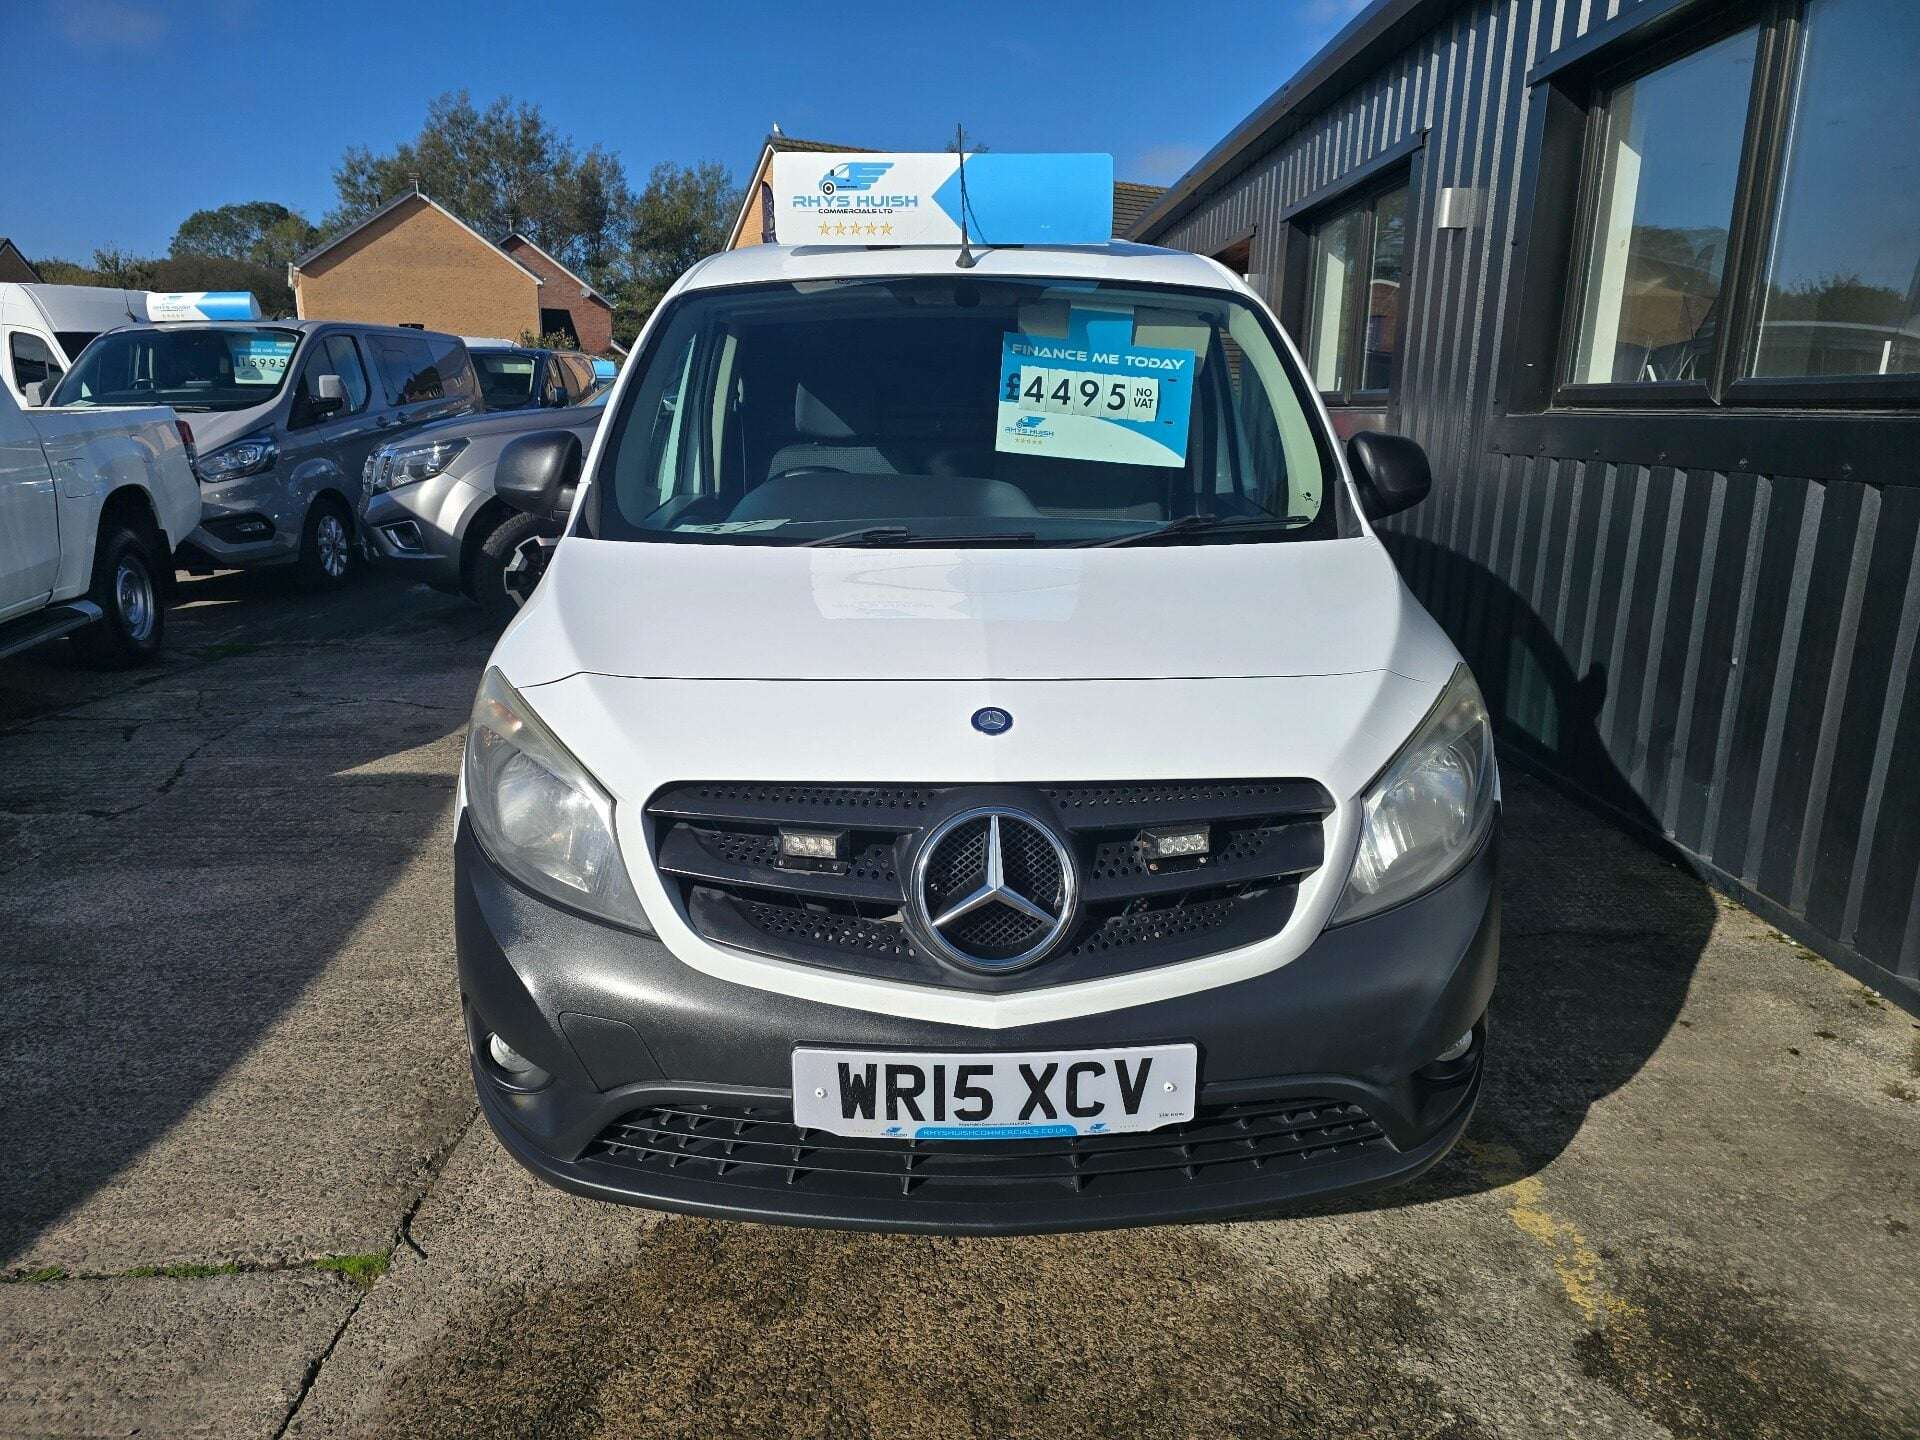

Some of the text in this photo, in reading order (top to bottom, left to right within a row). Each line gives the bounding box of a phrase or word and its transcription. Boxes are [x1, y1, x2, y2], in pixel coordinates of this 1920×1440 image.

[792, 195, 918, 208] RHYS HUISH
[1012, 343, 1186, 370] FINANCE ME TODAY
[1135, 387, 1153, 397] NO
[1133, 398, 1154, 409] VAT
[837, 1057, 1153, 1122] WR15 XCV
